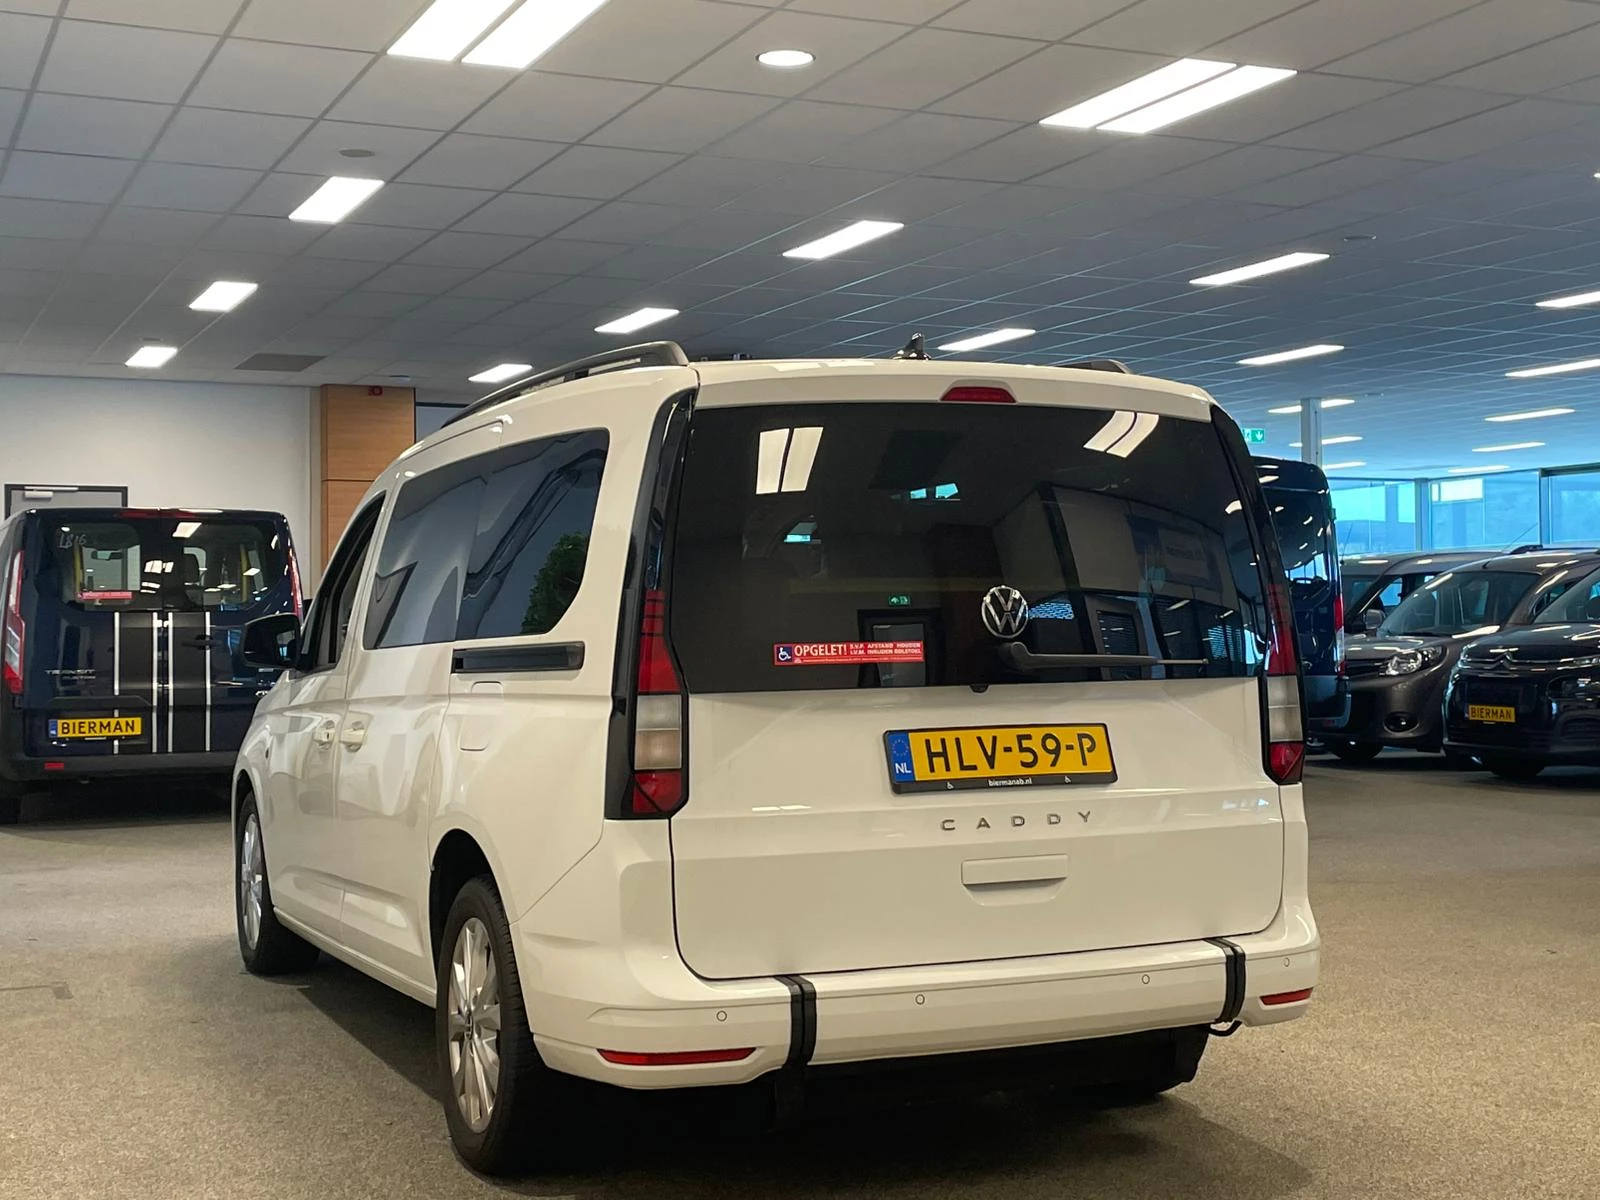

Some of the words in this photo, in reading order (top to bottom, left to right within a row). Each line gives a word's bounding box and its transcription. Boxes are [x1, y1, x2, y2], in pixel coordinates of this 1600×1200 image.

[794, 643, 847, 657] OPGELET!
[1471, 706, 1512, 720] BIERMAN
[61, 719, 135, 735] BIERMAN
[895, 762, 912, 775] NL
[924, 732, 1097, 774] HLV-59-P
[988, 778, 1032, 787] biermanab.nl
[940, 810, 1091, 831] CADDY
